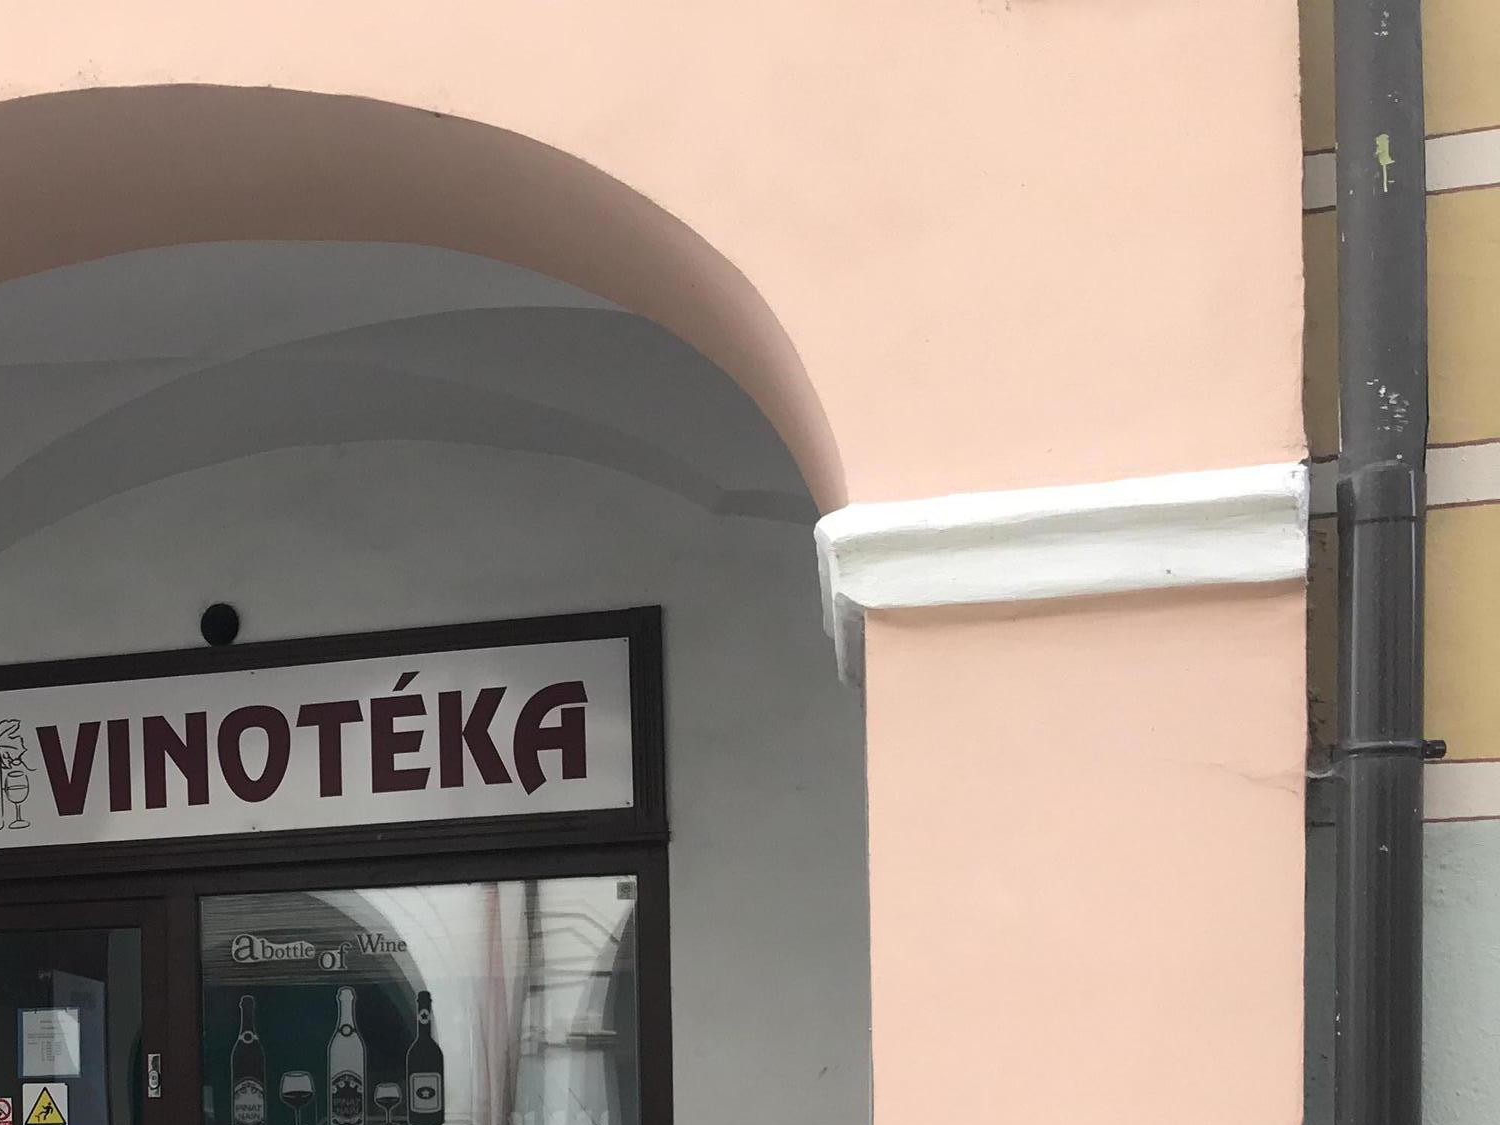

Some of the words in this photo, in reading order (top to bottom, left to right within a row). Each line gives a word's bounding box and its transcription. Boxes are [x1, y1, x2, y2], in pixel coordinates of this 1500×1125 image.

[35, 671, 589, 817] VINOTÉKA
[232, 934, 255, 962] a
[261, 940, 315, 960] bottle
[319, 942, 351, 970] of
[357, 933, 408, 954] Wine
